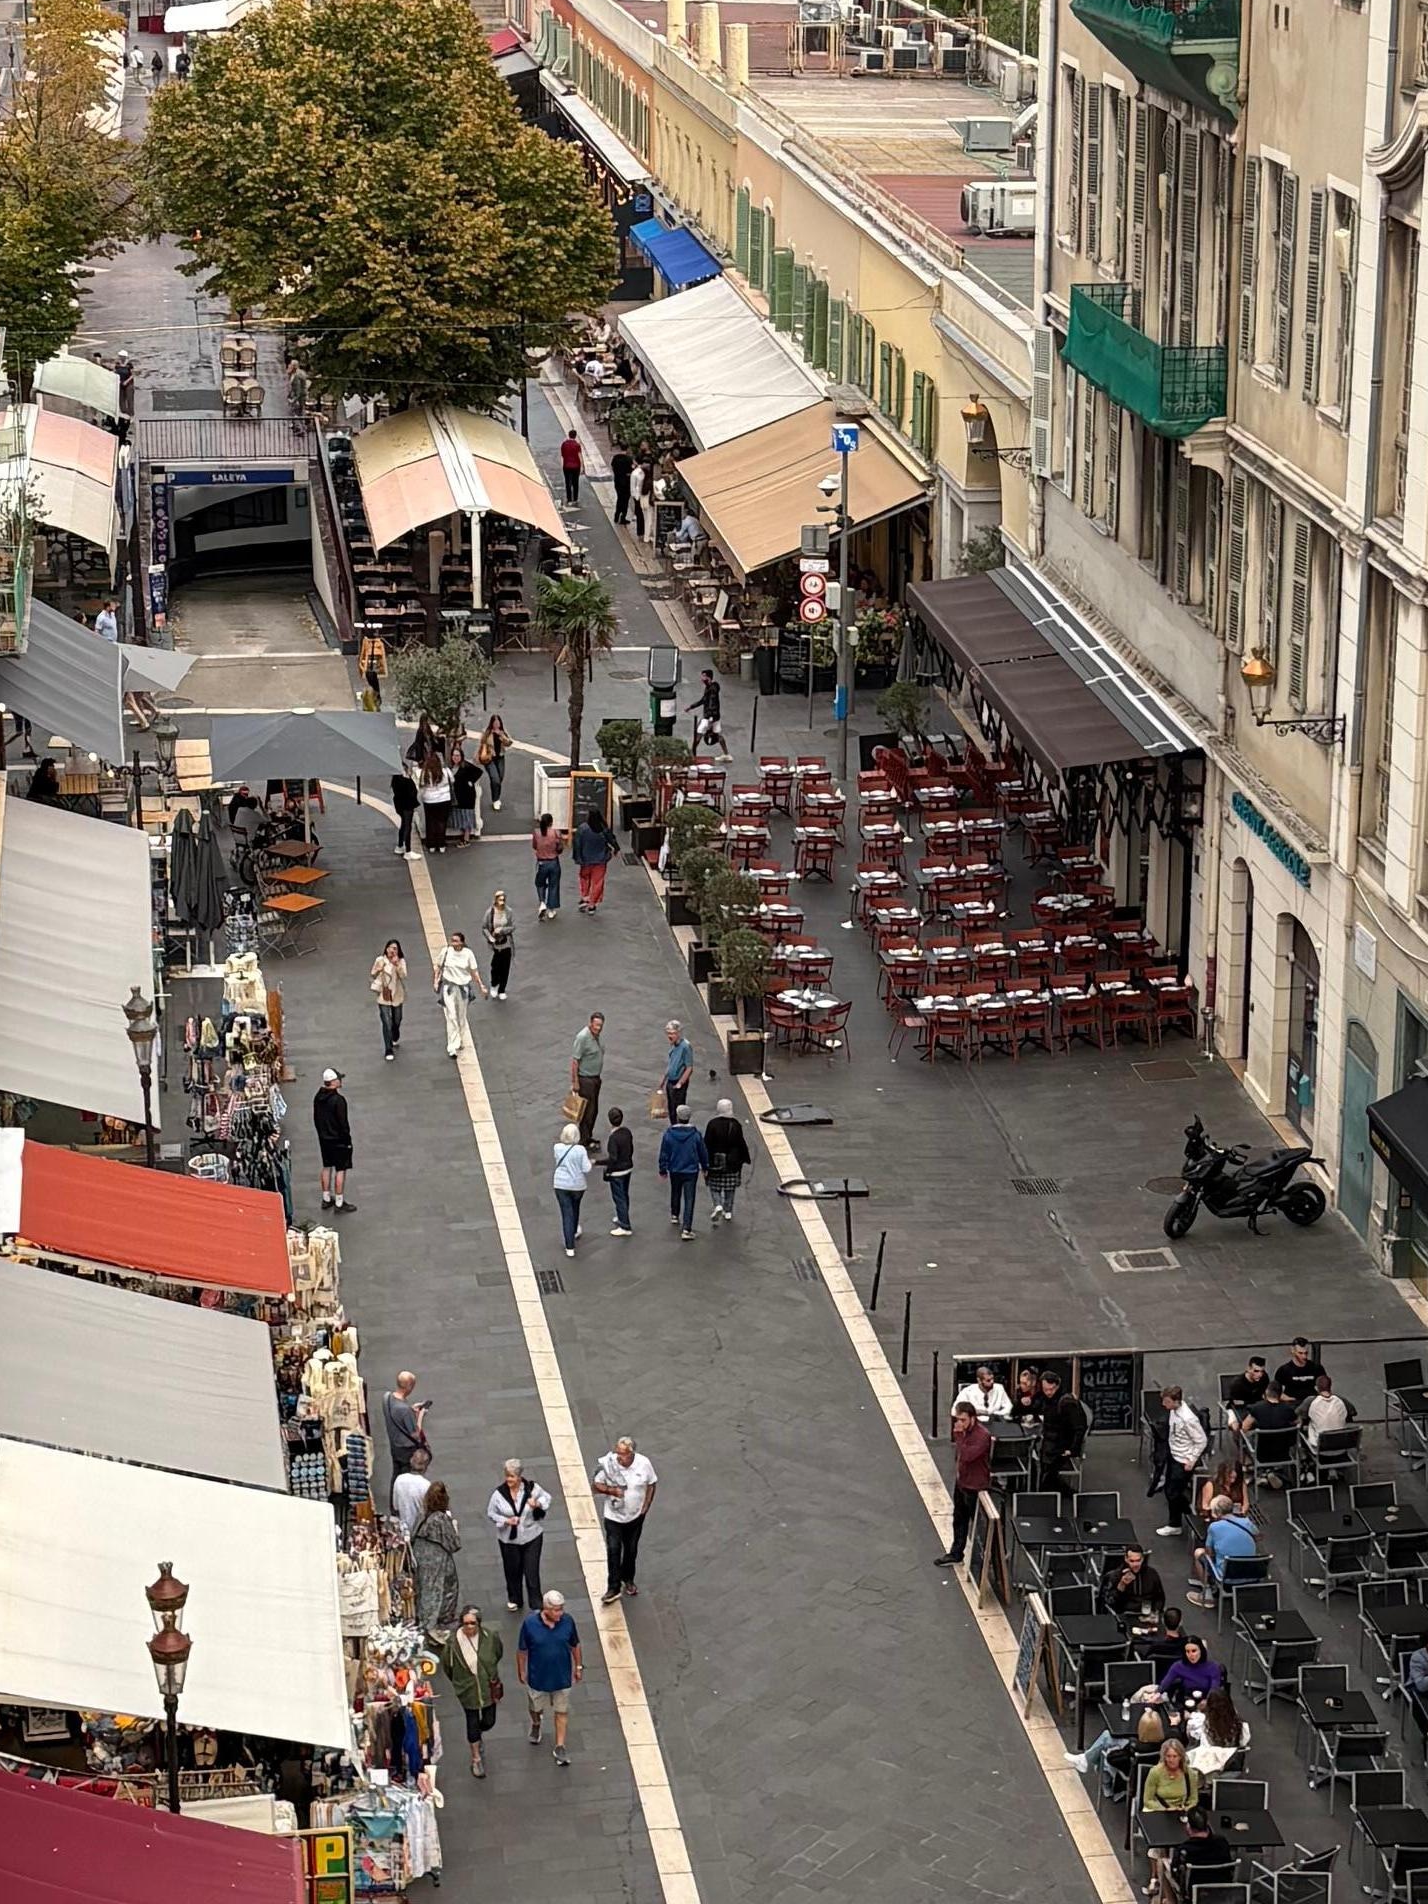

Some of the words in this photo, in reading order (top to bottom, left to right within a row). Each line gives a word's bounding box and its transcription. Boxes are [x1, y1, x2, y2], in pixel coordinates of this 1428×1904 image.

[838, 429, 857, 451] SOS
[211, 473, 247, 482] SALEYA
[1083, 1370, 1128, 1387] QUIZ
